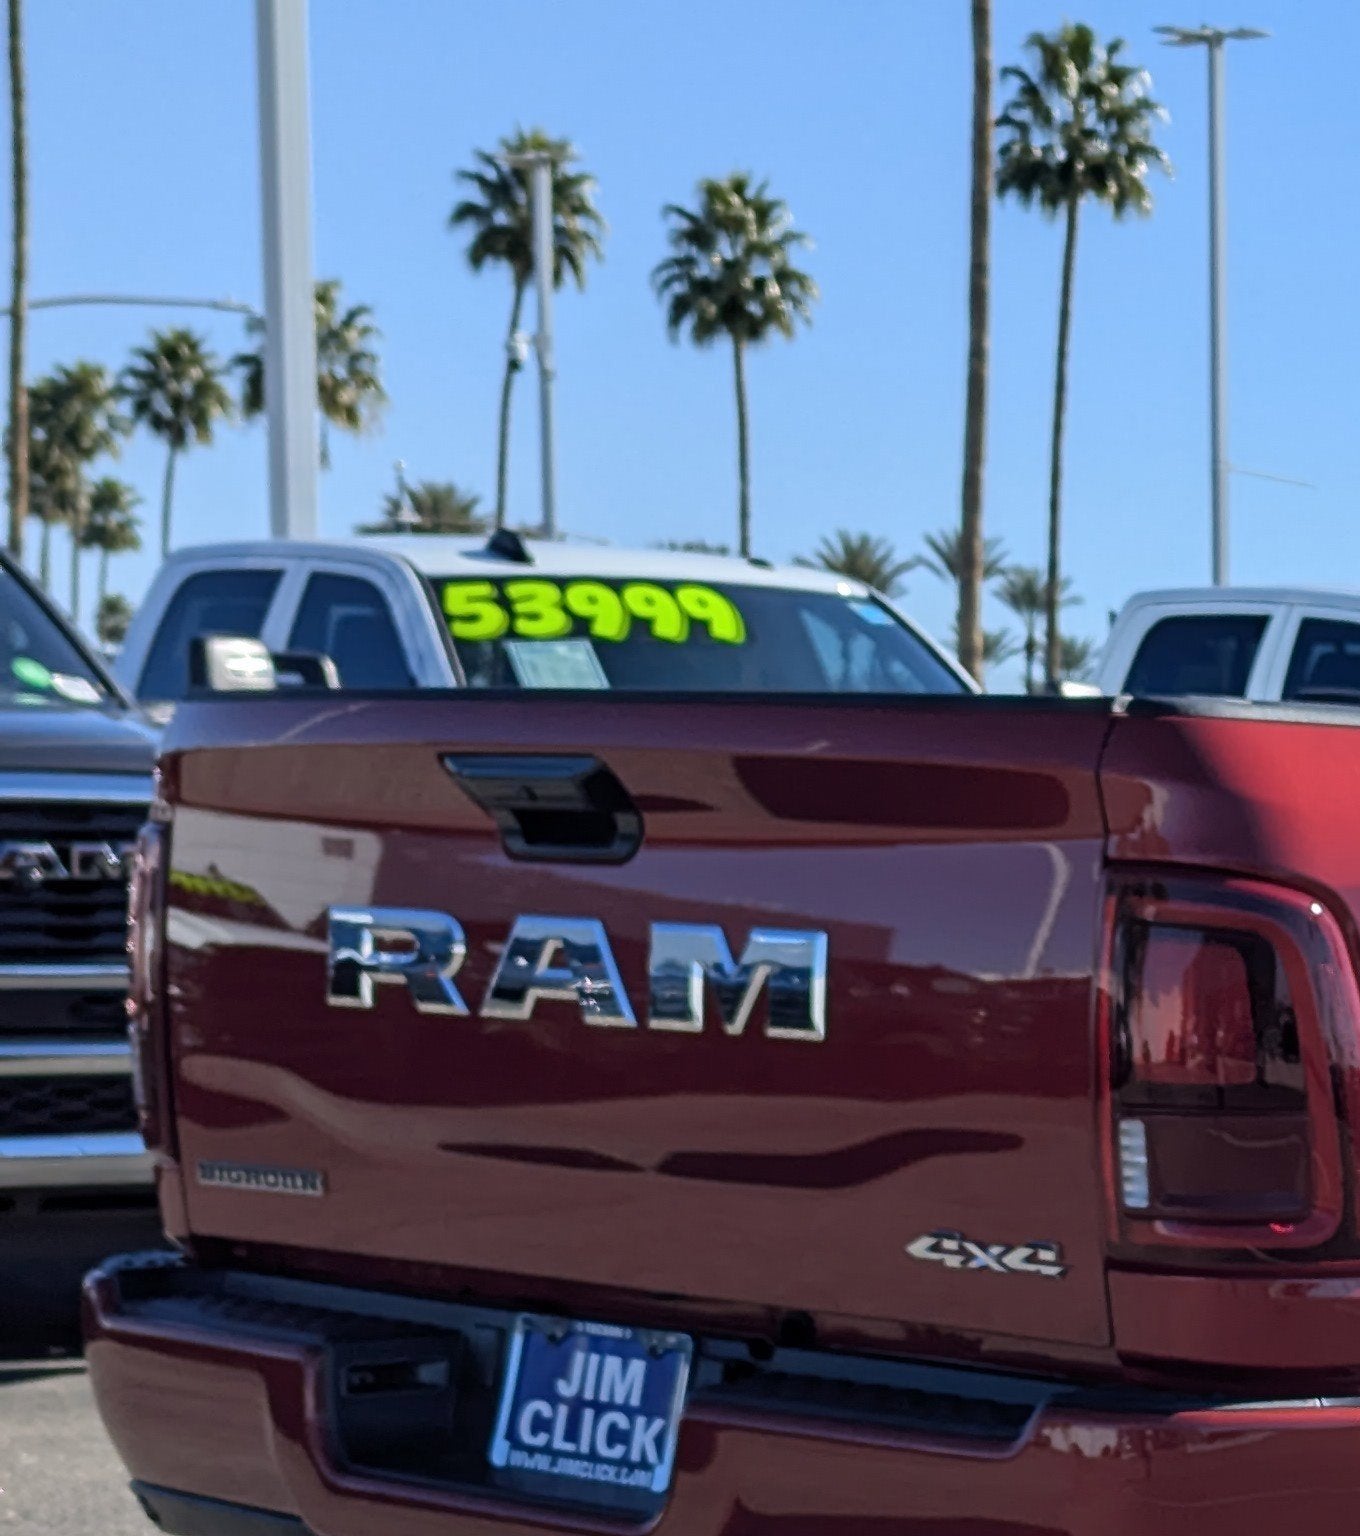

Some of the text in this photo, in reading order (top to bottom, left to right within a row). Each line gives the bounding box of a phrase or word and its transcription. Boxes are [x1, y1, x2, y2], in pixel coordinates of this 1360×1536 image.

[443, 580, 747, 644] 53999
[0, 839, 141, 880] AM
[326, 904, 829, 1042] RAM
[555, 1350, 647, 1407] JIM
[517, 1399, 667, 1465] CLICK
